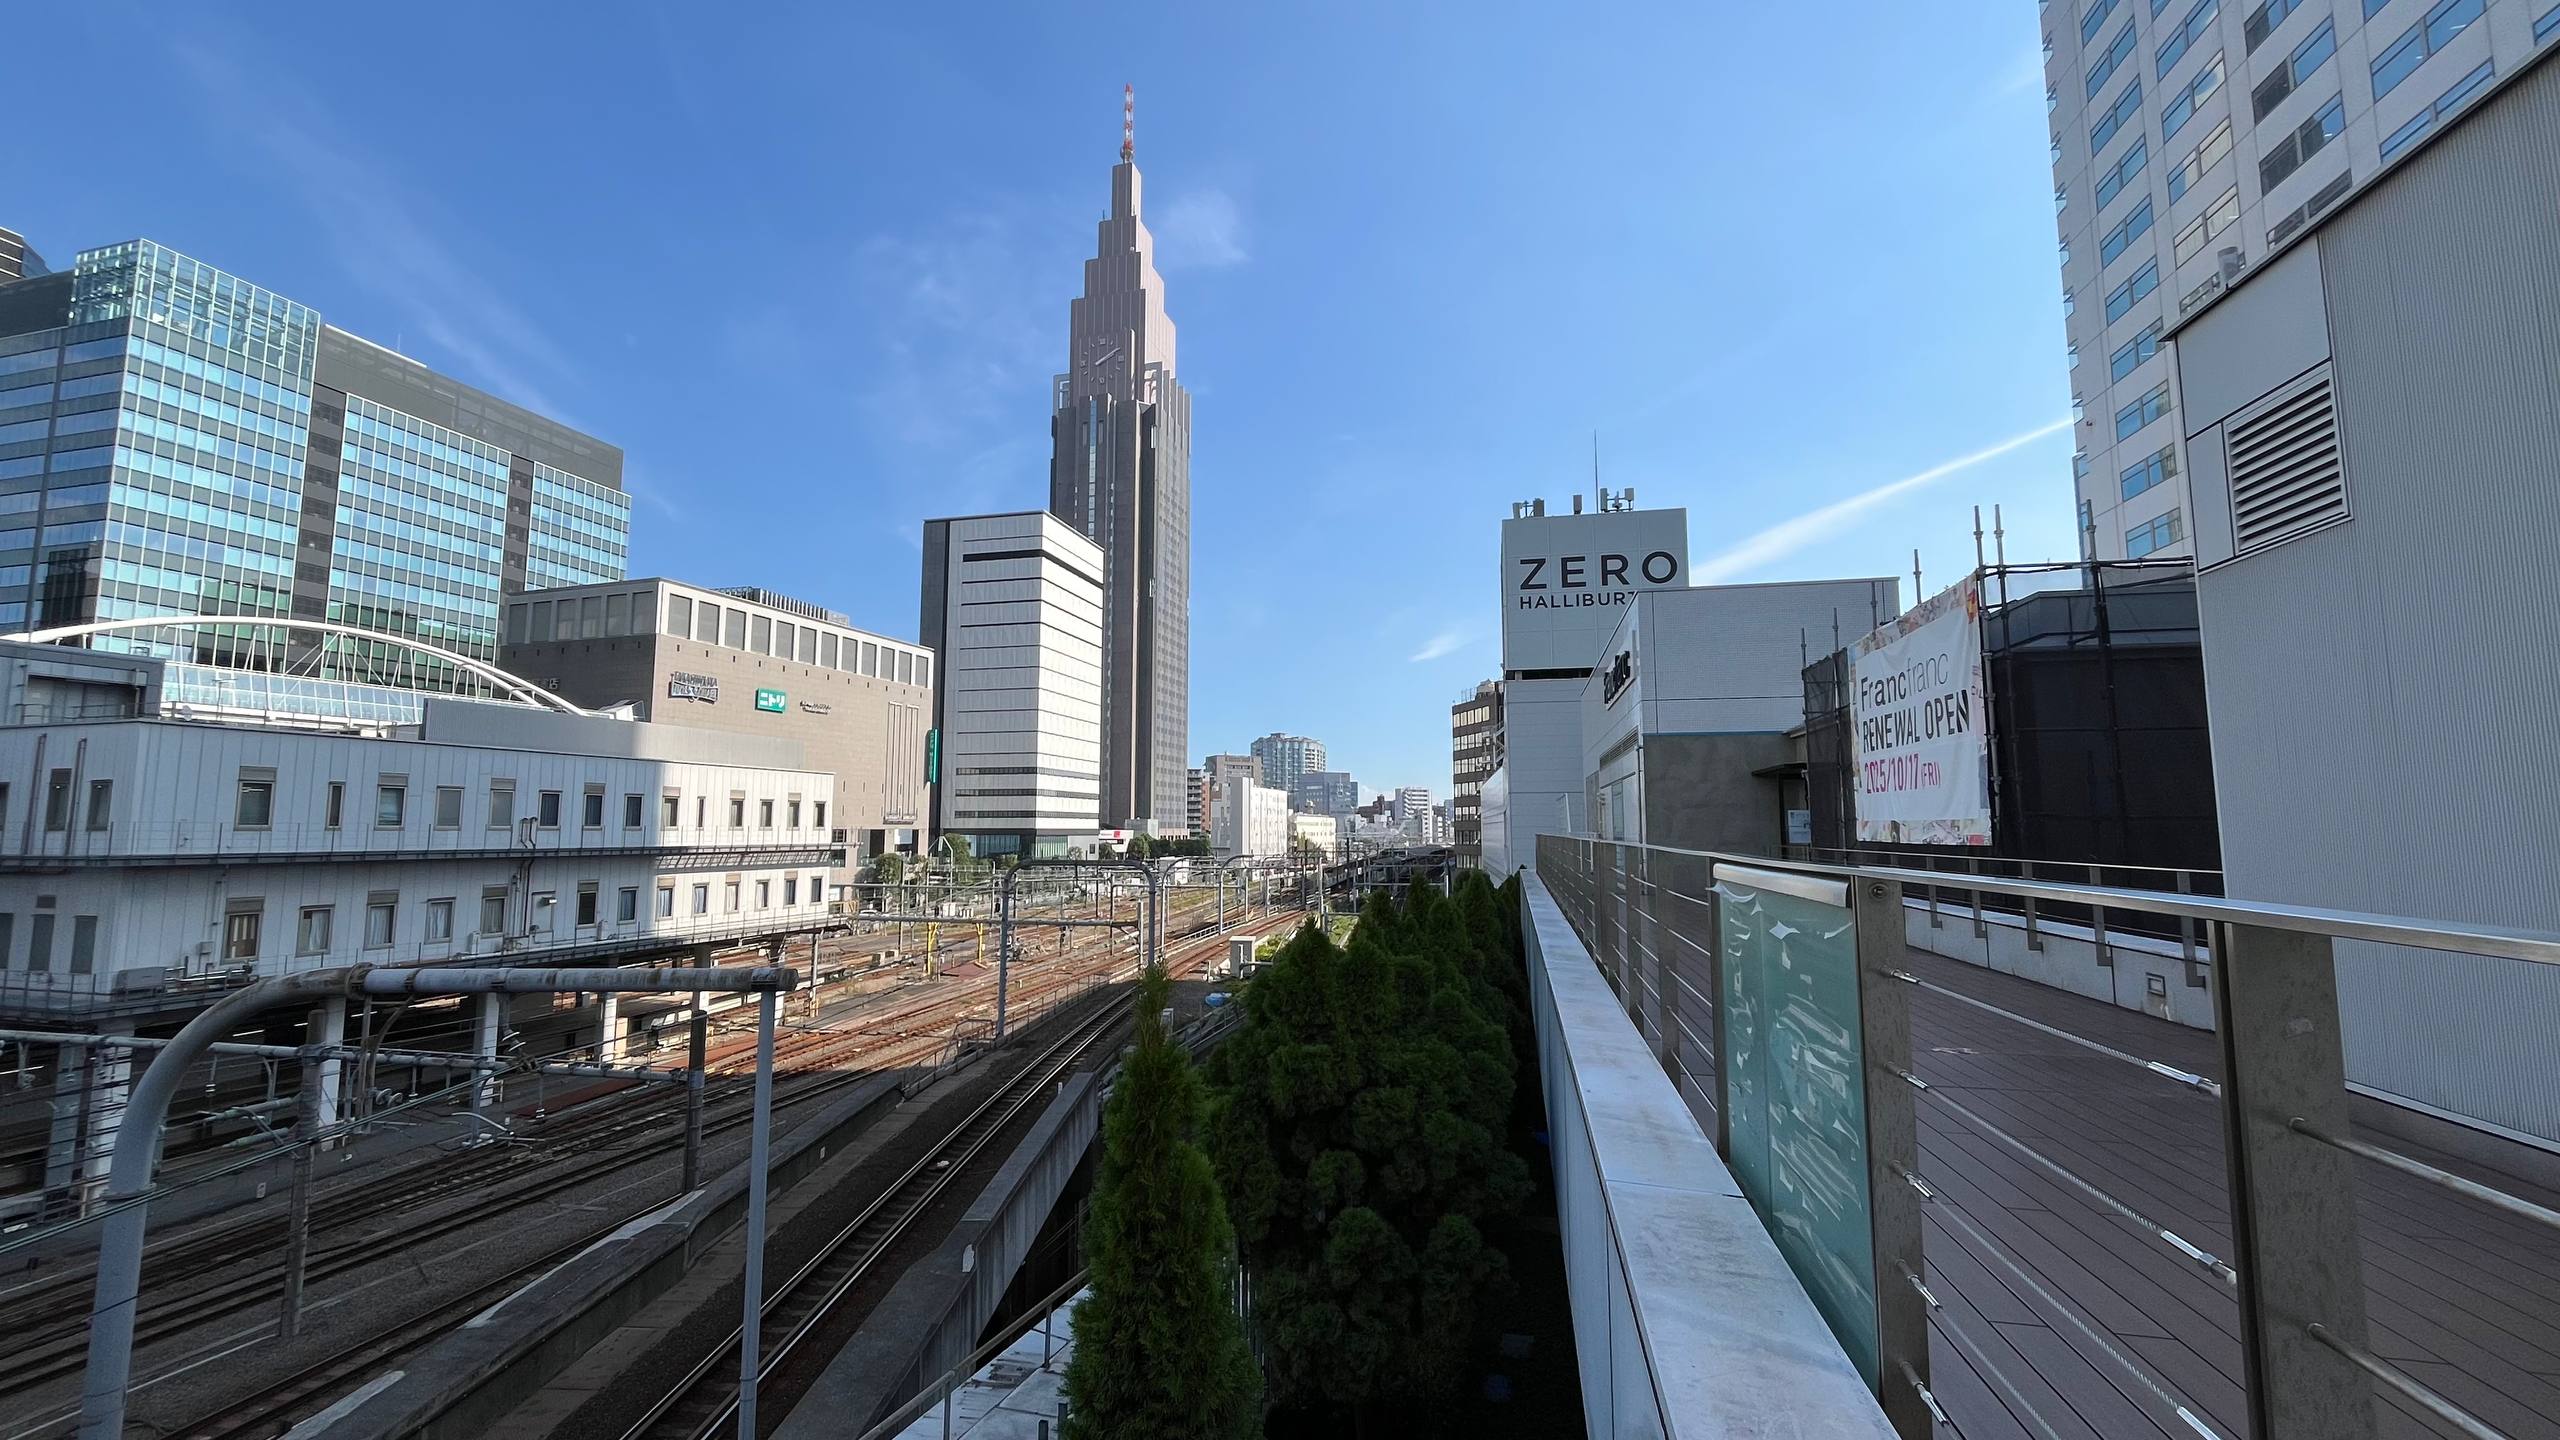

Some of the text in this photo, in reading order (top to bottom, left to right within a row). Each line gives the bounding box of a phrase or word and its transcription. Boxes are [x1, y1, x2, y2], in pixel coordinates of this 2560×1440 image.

[1520, 551, 1678, 590] ZERO
[759, 692, 785, 708] ニトリ
[1860, 653, 1949, 711] Francfranc
[1863, 689, 1970, 754] RENEWAL OPEN
[1864, 753, 1941, 794] 2025/10/17 (FRI)
